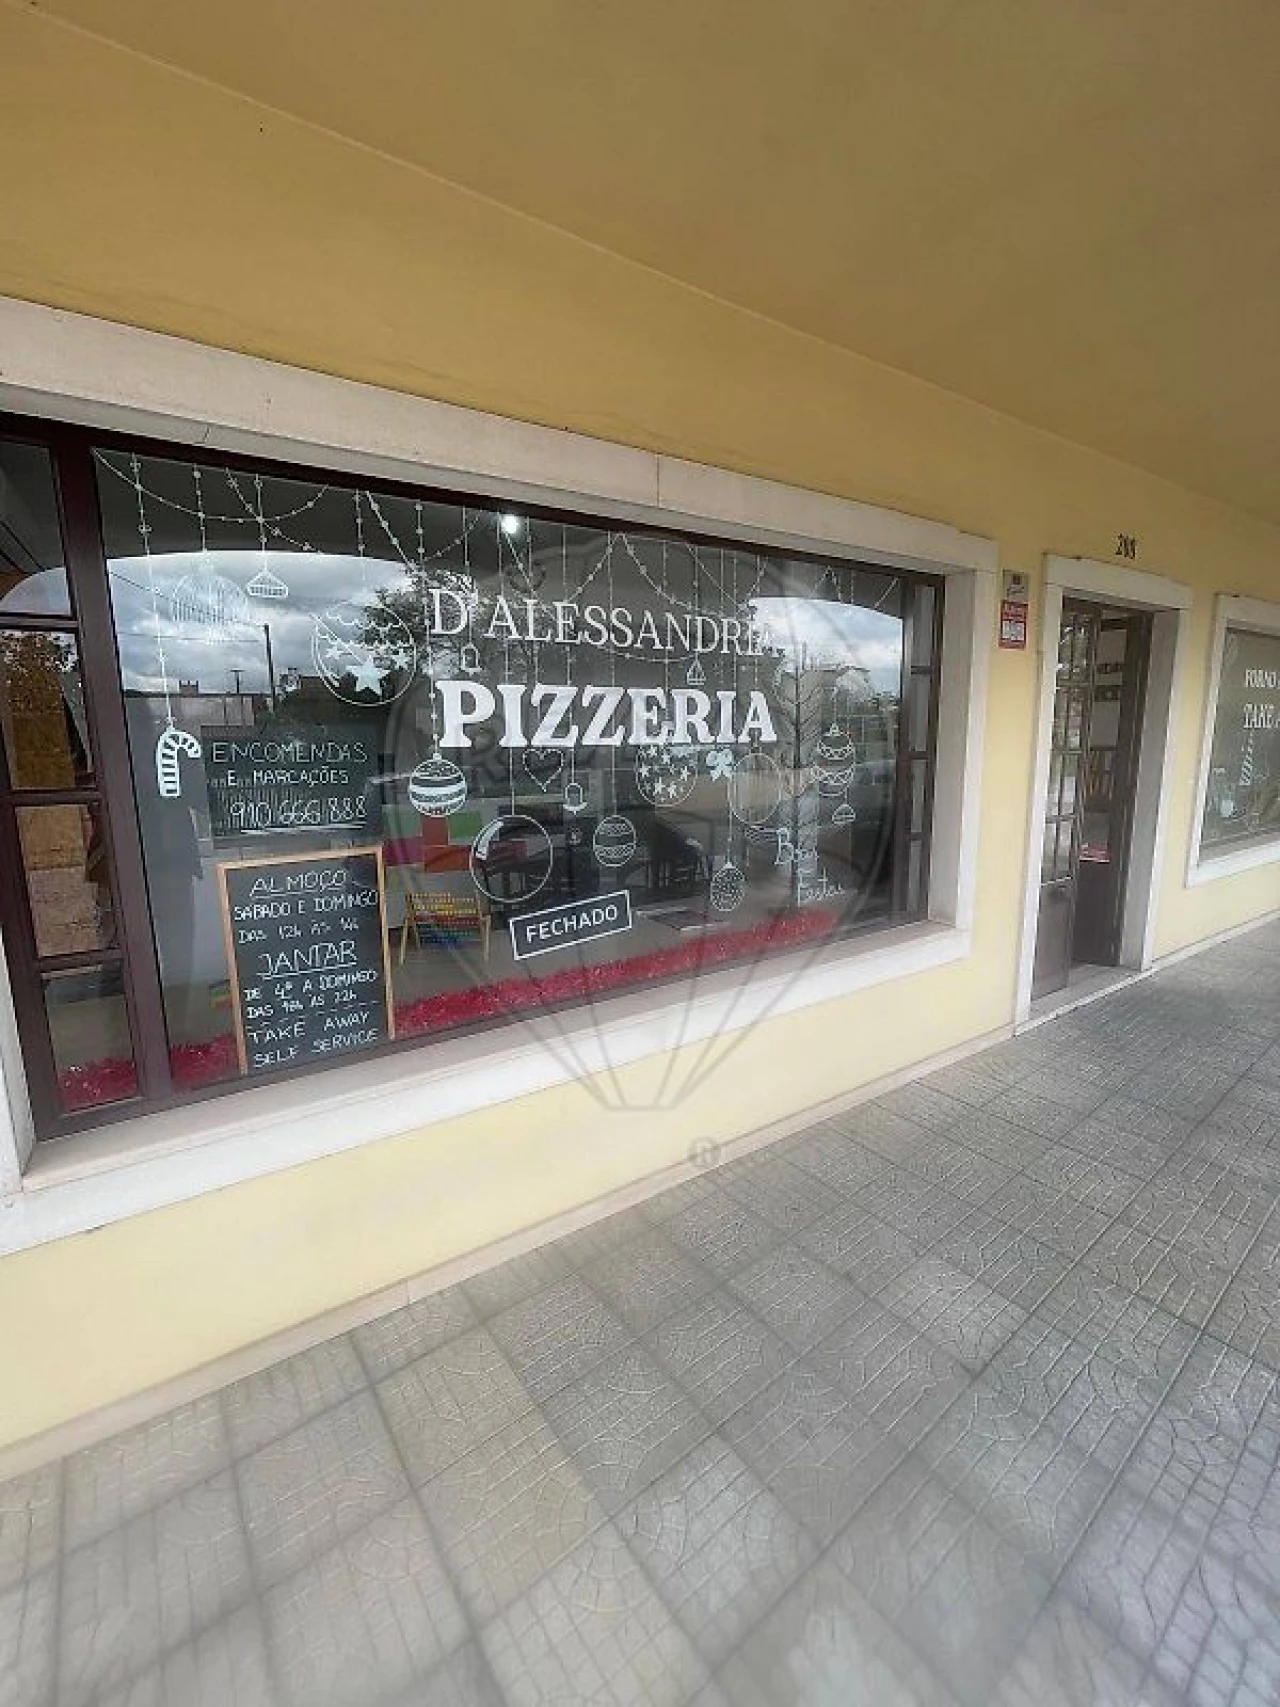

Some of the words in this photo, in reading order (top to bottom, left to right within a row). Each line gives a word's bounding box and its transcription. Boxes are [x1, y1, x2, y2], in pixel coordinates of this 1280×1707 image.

[434, 679, 778, 748] PIZZERIA
[1243, 703, 1274, 729] TAKE
[212, 741, 368, 764] ENCOMENDAS
[227, 769, 238, 786] E
[253, 765, 349, 788] MARCAÇÕES
[278, 798, 321, 826] 666
[327, 795, 368, 823] 888
[249, 869, 347, 897] ALMOÇO
[297, 899, 306, 914] E
[313, 889, 379, 912] DOMINGO
[526, 904, 618, 944] FECHADO
[257, 940, 358, 976] JANTAR
[243, 987, 262, 1002] DE
[302, 978, 313, 993] A
[319, 969, 379, 991] DOMINGO
[246, 1004, 274, 1019] DAS
[247, 1021, 306, 1045] TAKE
[323, 1010, 370, 1032] AWAY
[253, 1045, 300, 1068] SELF
[311, 1028, 379, 1053] SERVICE
